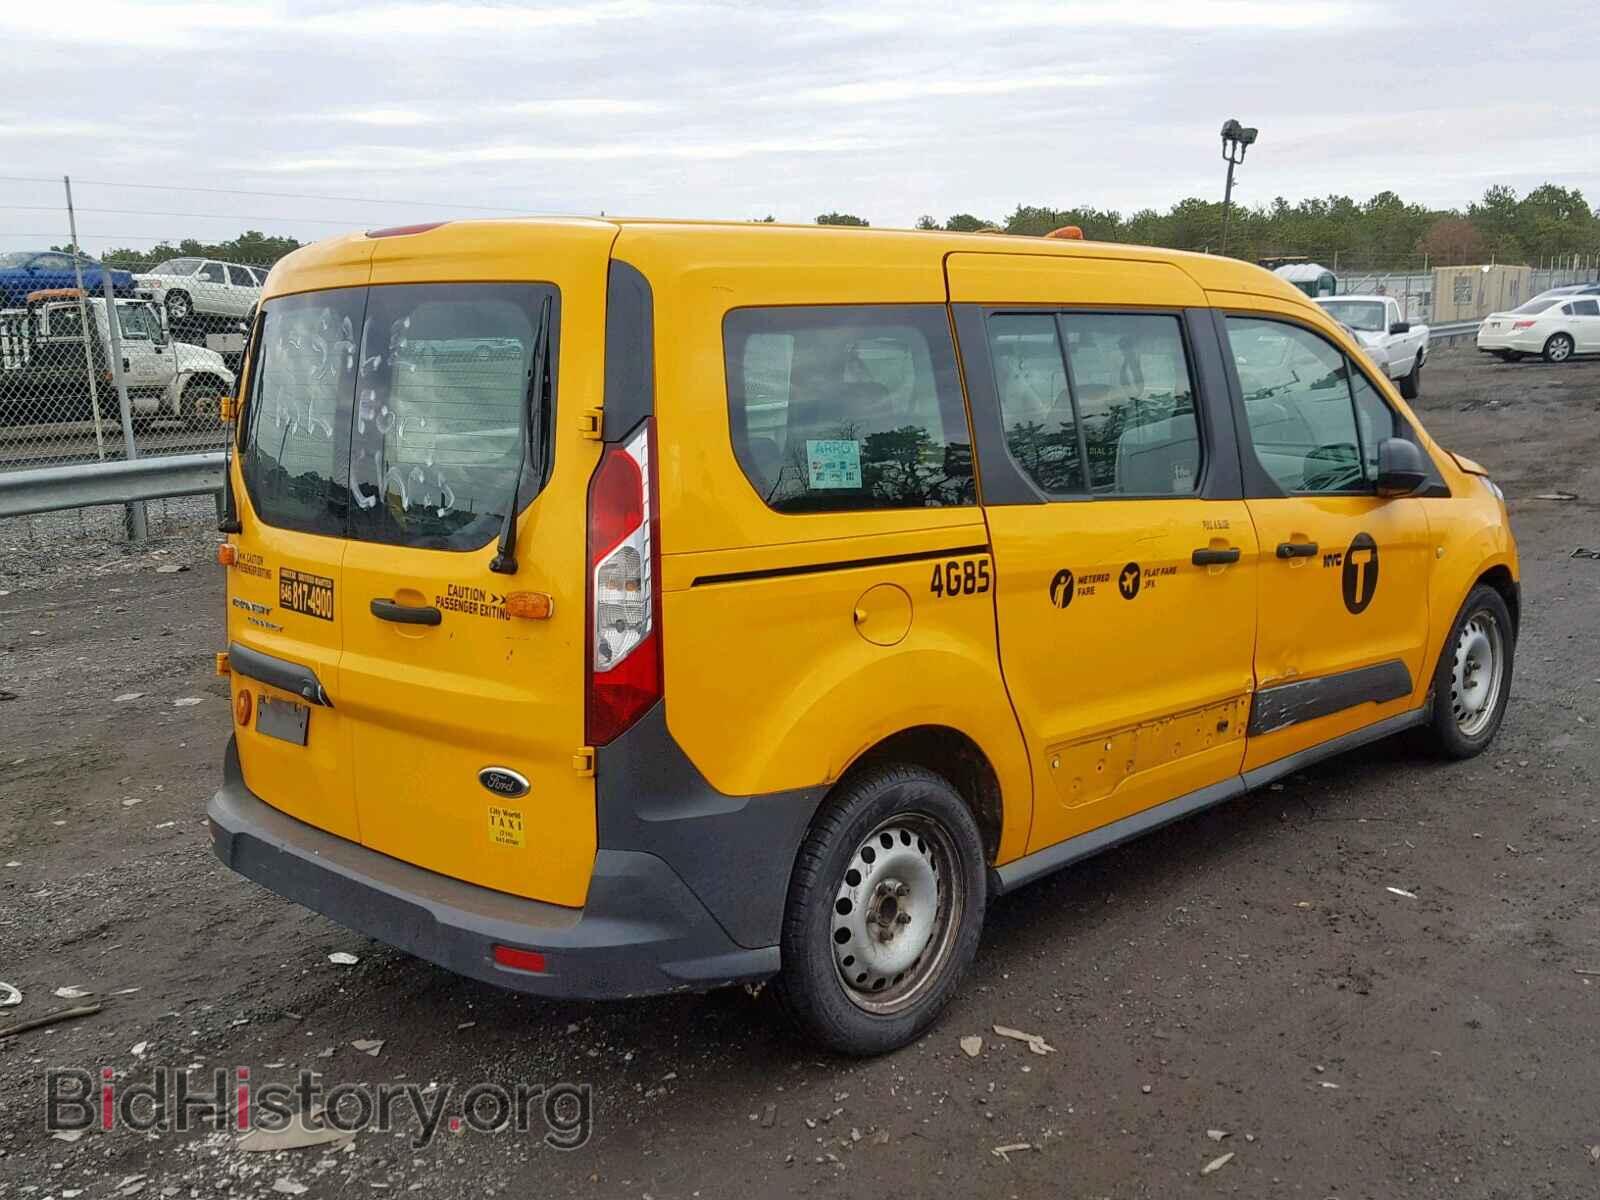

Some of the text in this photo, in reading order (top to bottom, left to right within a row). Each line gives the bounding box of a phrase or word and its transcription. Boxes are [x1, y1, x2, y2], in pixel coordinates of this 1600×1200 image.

[1323, 552, 1342, 568] NYC
[930, 559, 990, 598] 4G85
[1077, 573, 1110, 585] METERED
[1144, 566, 1178, 578] FLAT FARE
[447, 583, 487, 603] CAUTION
[1077, 585, 1096, 596] FARE
[292, 581, 332, 619] 817-4900
[435, 595, 511, 621] PASSENGER EXITING
[487, 773, 514, 792] Ford
[491, 815, 522, 832] TAXI
